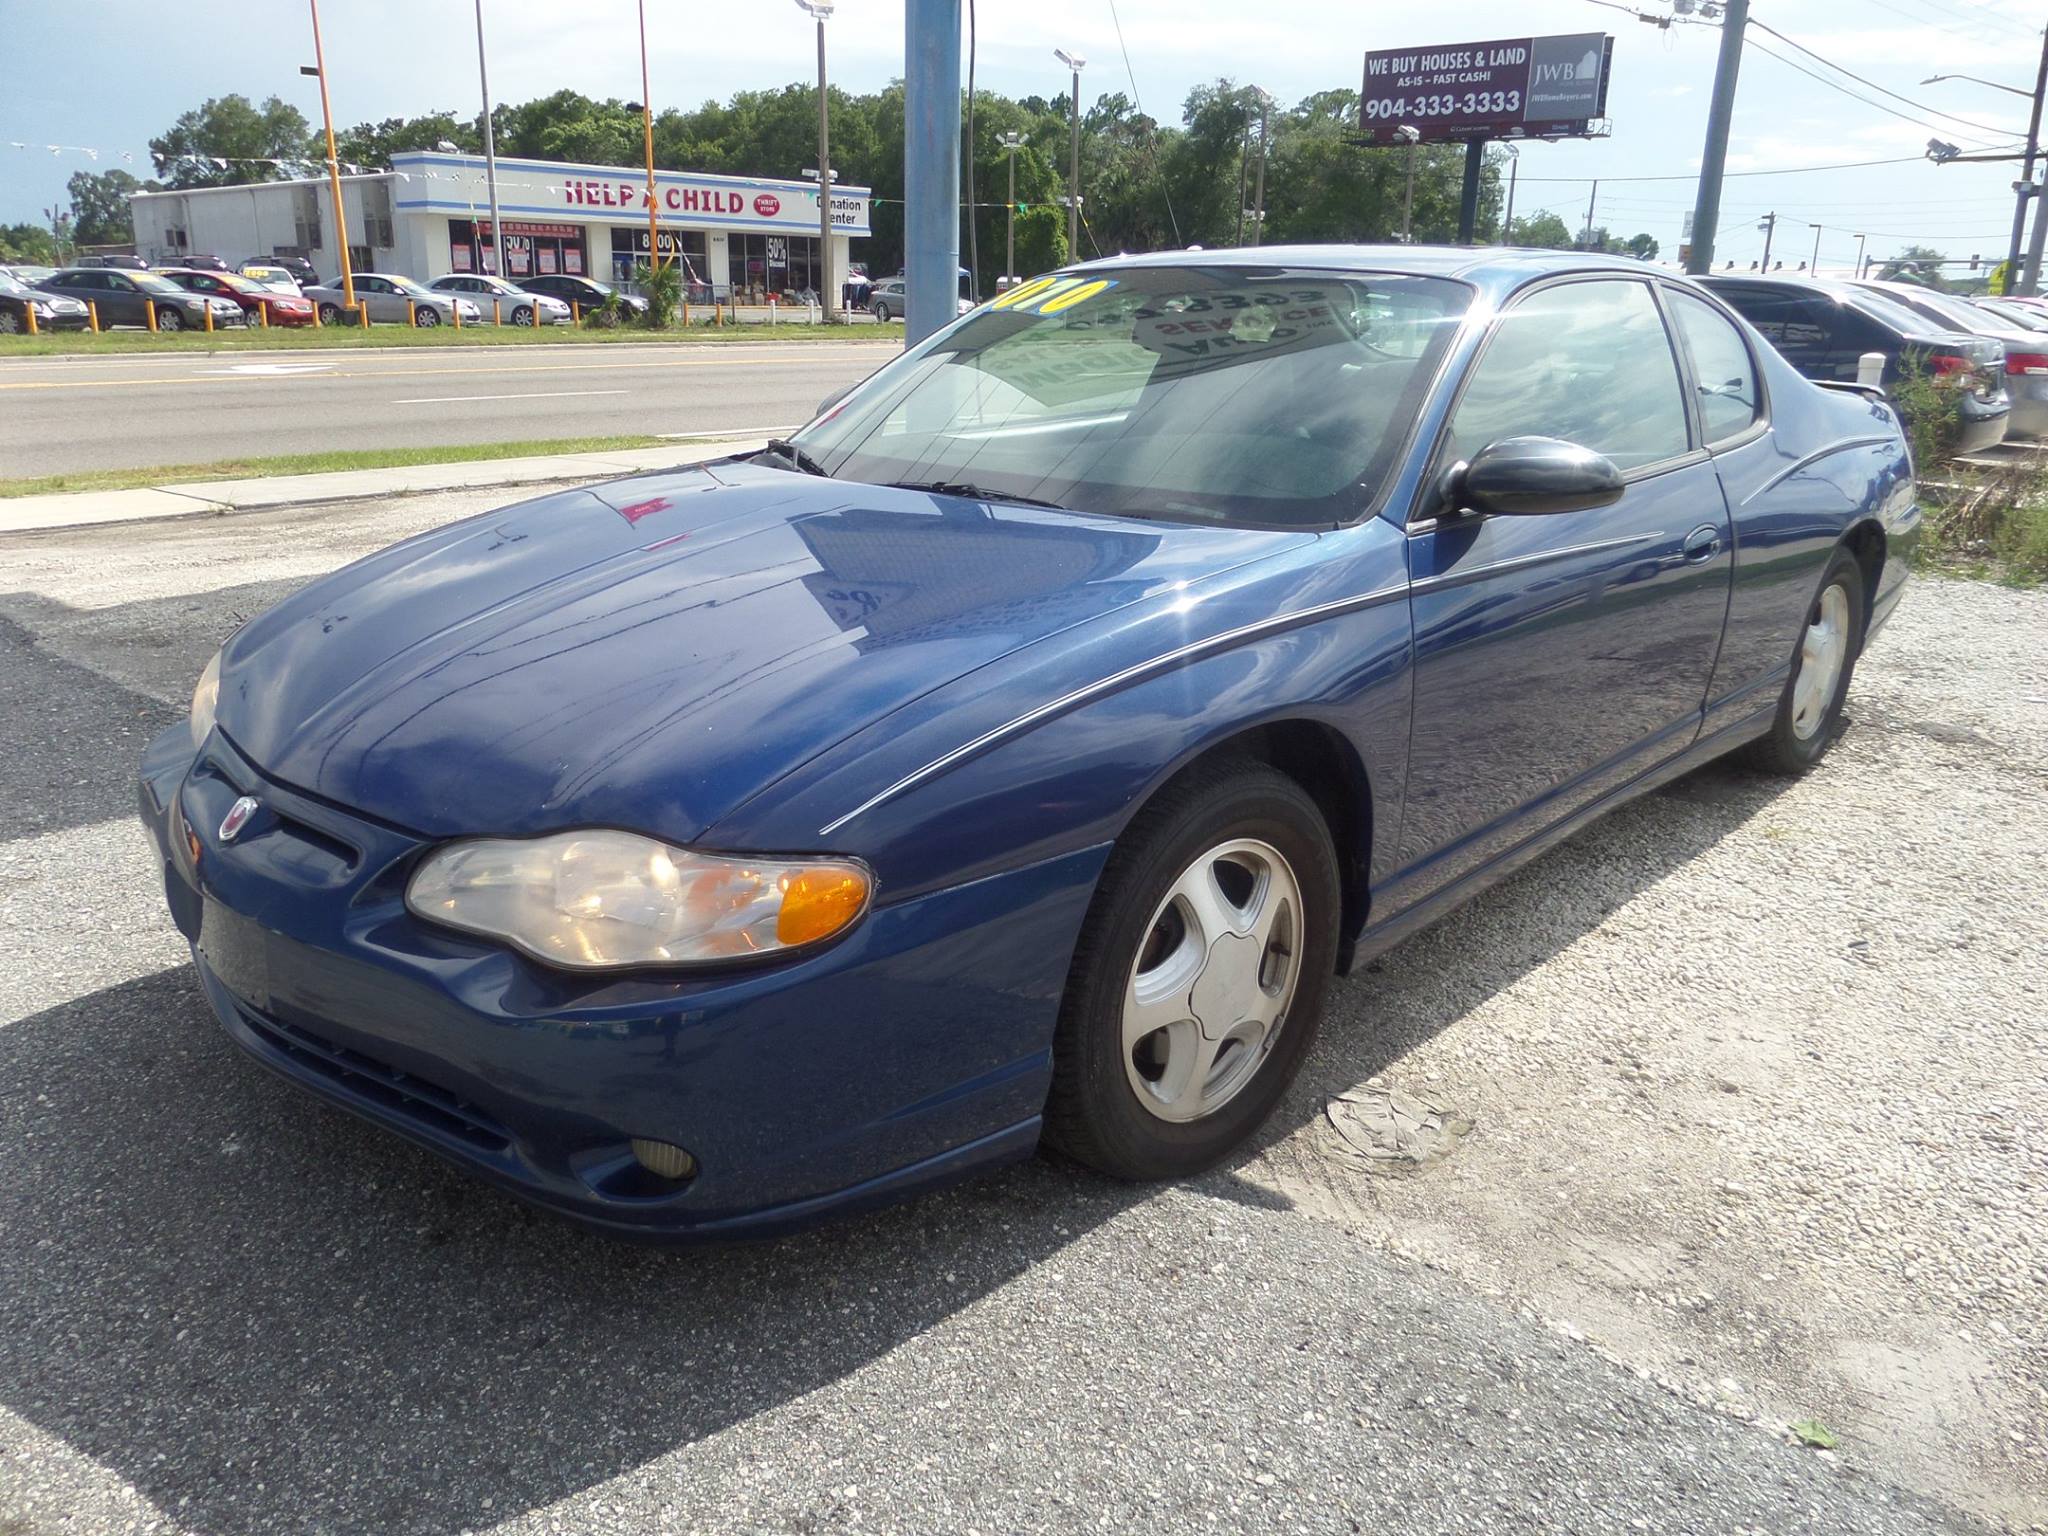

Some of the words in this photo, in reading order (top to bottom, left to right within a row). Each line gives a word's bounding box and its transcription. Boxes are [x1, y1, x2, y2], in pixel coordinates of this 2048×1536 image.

[1369, 58, 1388, 75] WE
[1392, 55, 1418, 74] BUY
[1421, 51, 1471, 72] HOUSES
[1474, 50, 1486, 67] &
[1489, 47, 1526, 66] LAND
[1397, 75, 1423, 88] AS-IS
[1433, 73, 1457, 85] FAST
[1459, 71, 1491, 83] CASH!
[1533, 62, 1575, 88] JWB
[1366, 90, 1520, 119] 904-333-3333
[565, 181, 634, 207] HELP
[666, 187, 744, 214] CHILD
[757, 198, 778, 206] THRIFT
[816, 195, 861, 212] Dnation
[829, 213, 856, 225] enter
[642, 233, 671, 249] 800
[768, 237, 787, 260] 50%
